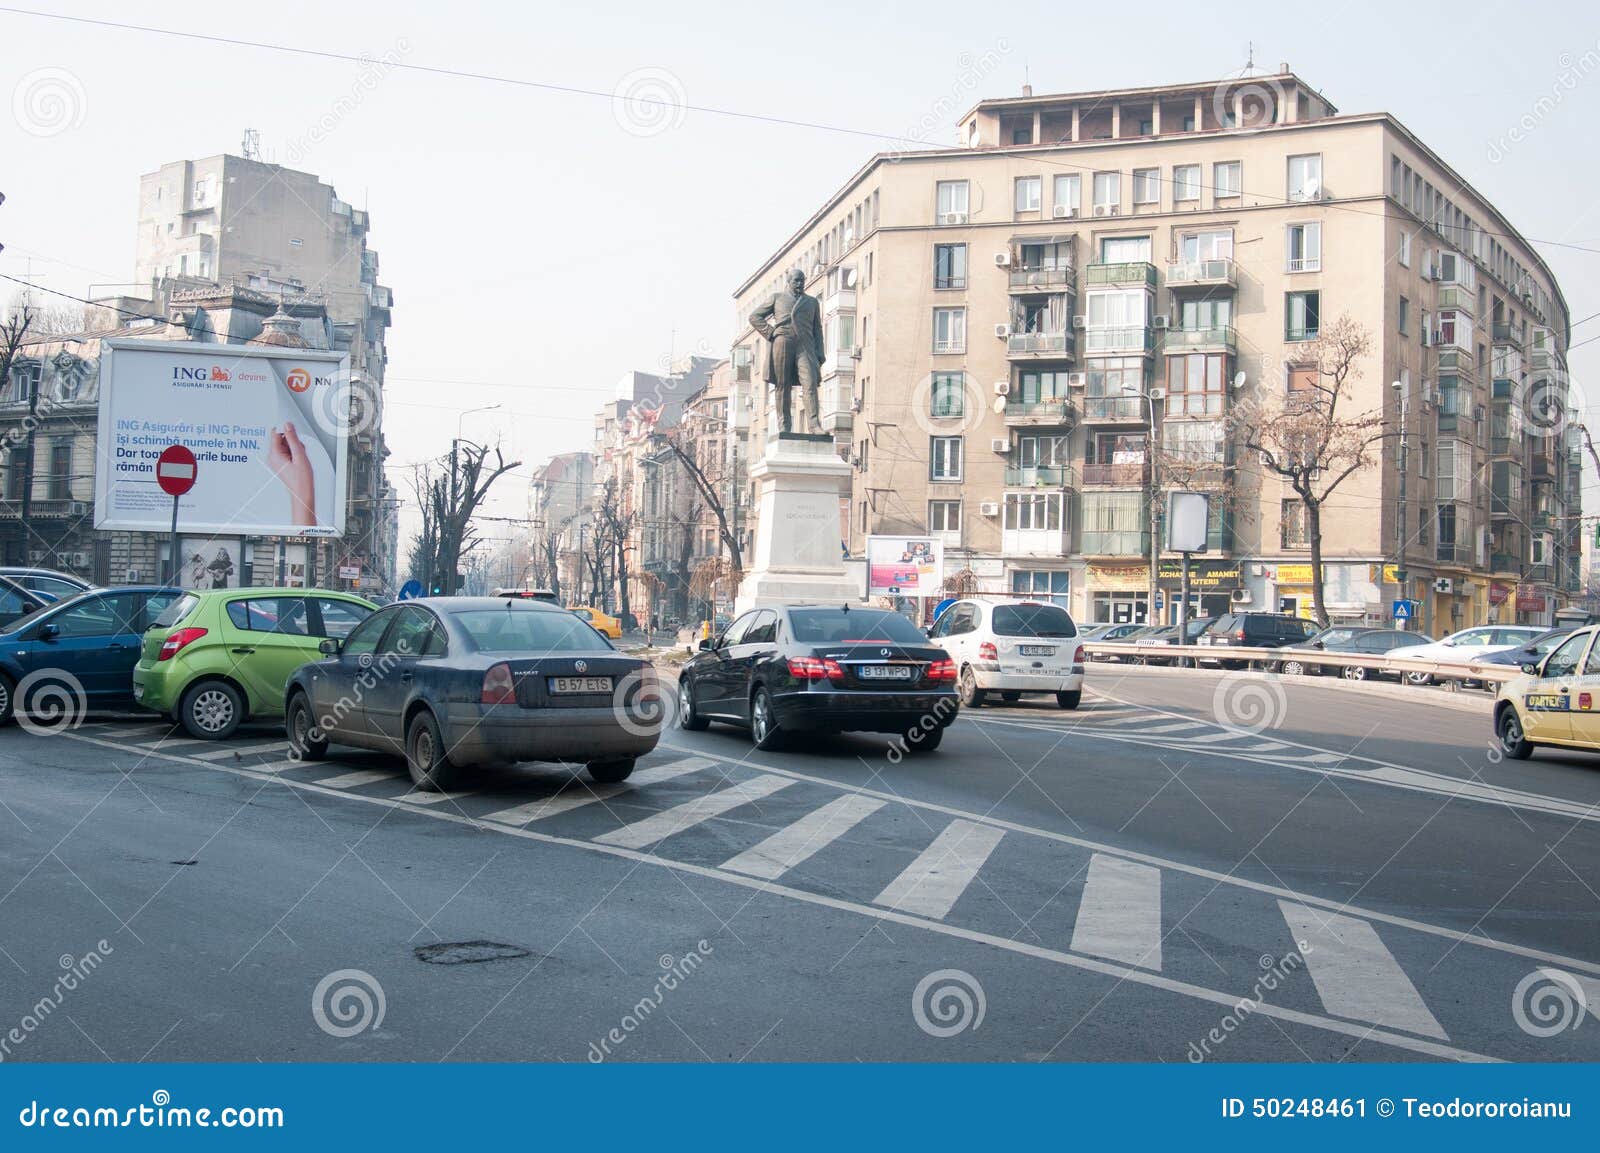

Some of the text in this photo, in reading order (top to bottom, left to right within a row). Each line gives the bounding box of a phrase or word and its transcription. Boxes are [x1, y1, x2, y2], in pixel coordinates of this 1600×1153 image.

[173, 367, 207, 381] ING
[238, 373, 267, 382] devine
[315, 377, 332, 387] NN
[117, 420, 139, 431] ING
[208, 424, 229, 435] ING
[233, 426, 266, 437] Pensii
[183, 436, 224, 448] numele
[226, 437, 237, 449] în
[240, 439, 260, 450] NN.
[116, 447, 248, 463] Dar toa urile bune
[1206, 570, 1240, 578] AMANET
[864, 666, 908, 677] B 131 WPO
[558, 678, 609, 691] B 57 ETS
